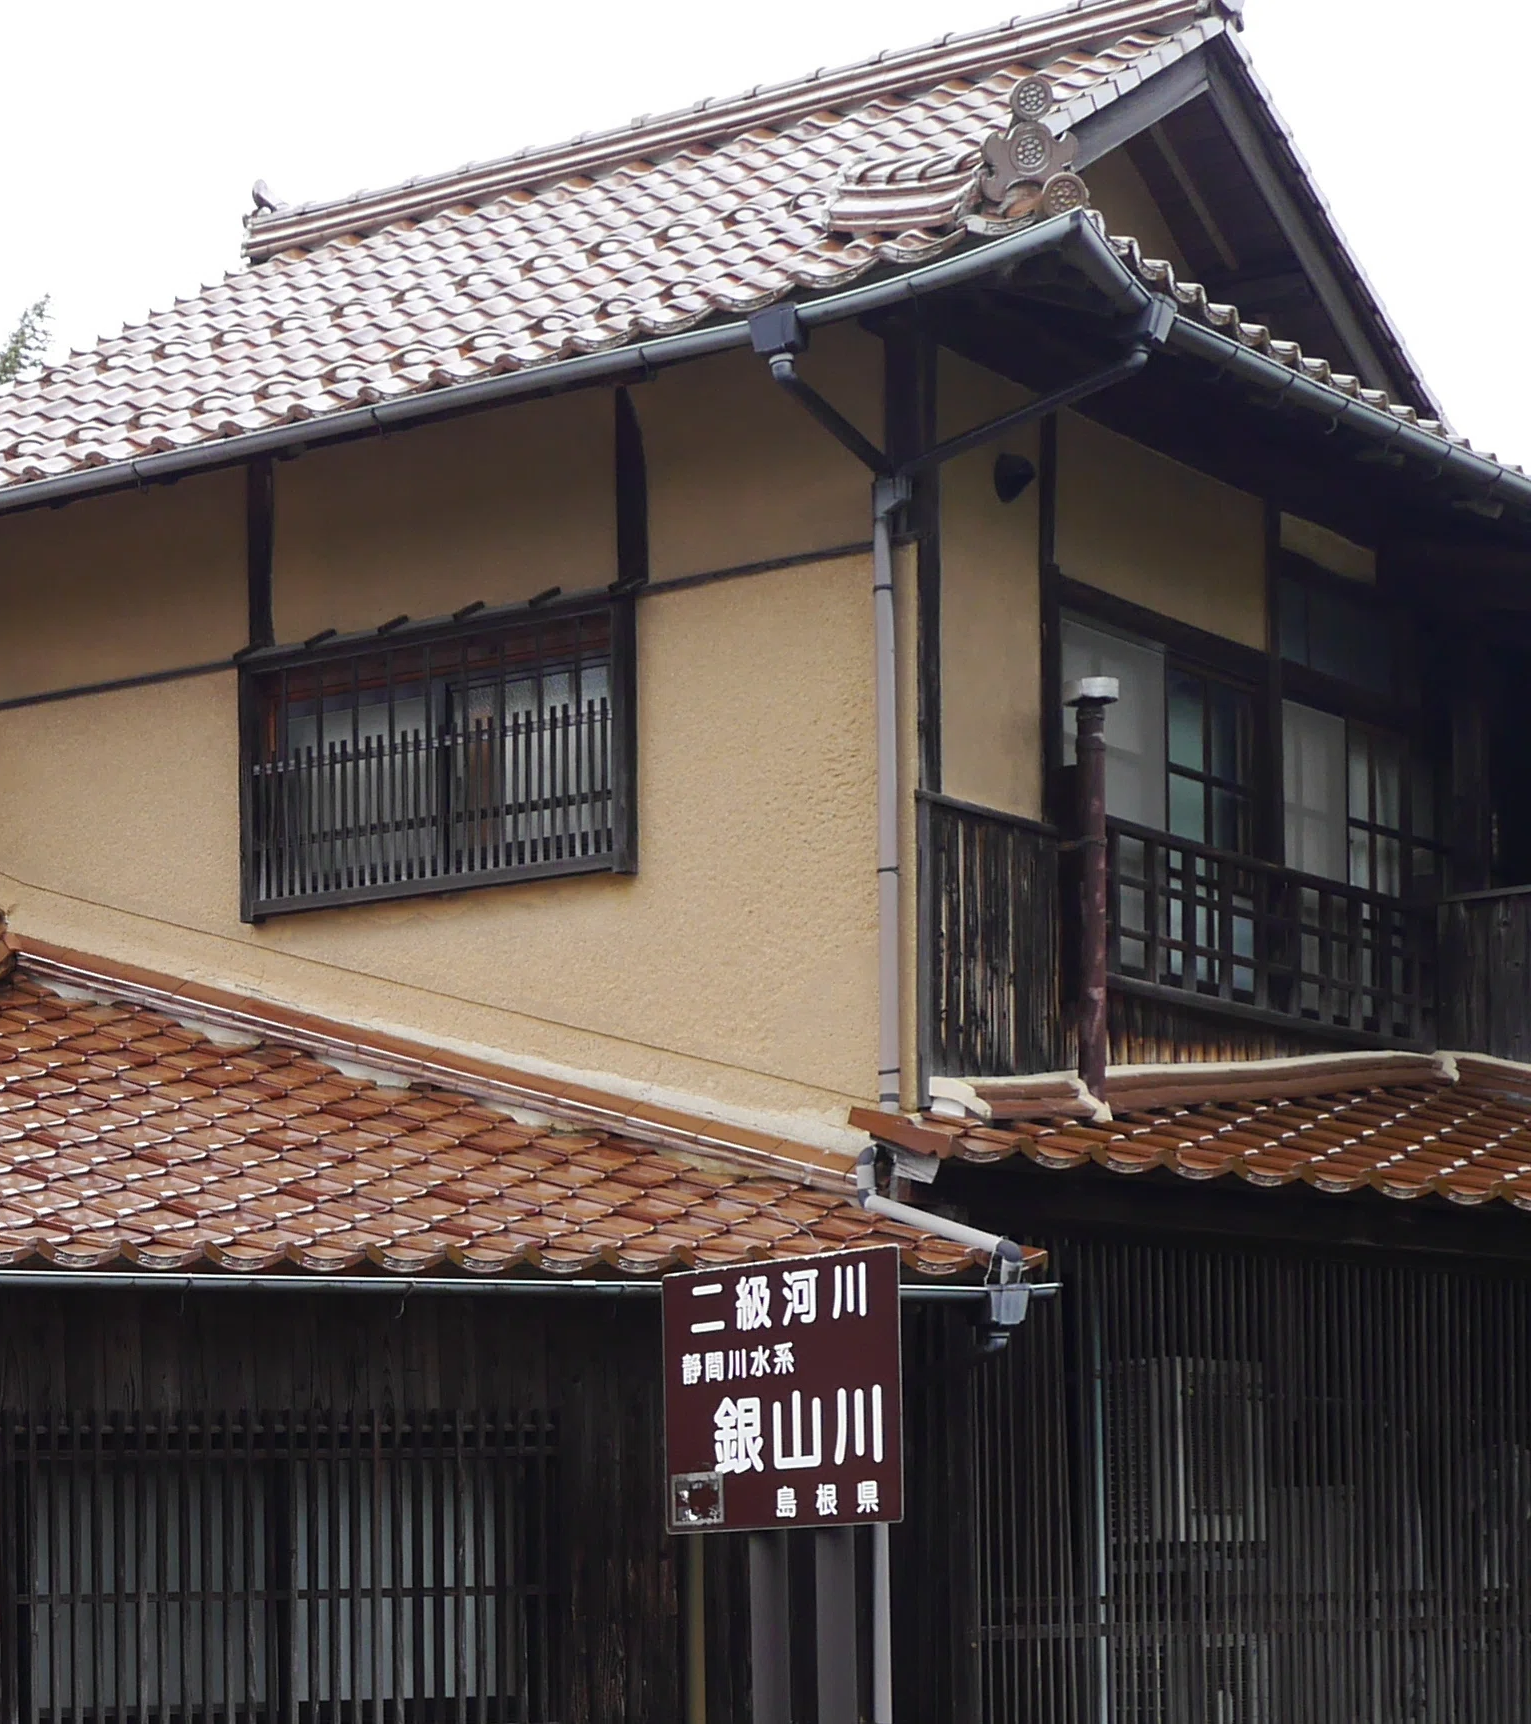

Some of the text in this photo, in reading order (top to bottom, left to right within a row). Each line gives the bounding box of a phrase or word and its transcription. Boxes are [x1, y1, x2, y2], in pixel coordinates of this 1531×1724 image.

[691, 1261, 867, 1334] 二級河川
[681, 1342, 795, 1385] 静間川水系
[713, 1384, 884, 1474] 銀山川
[775, 1479, 880, 1518] 島根県
